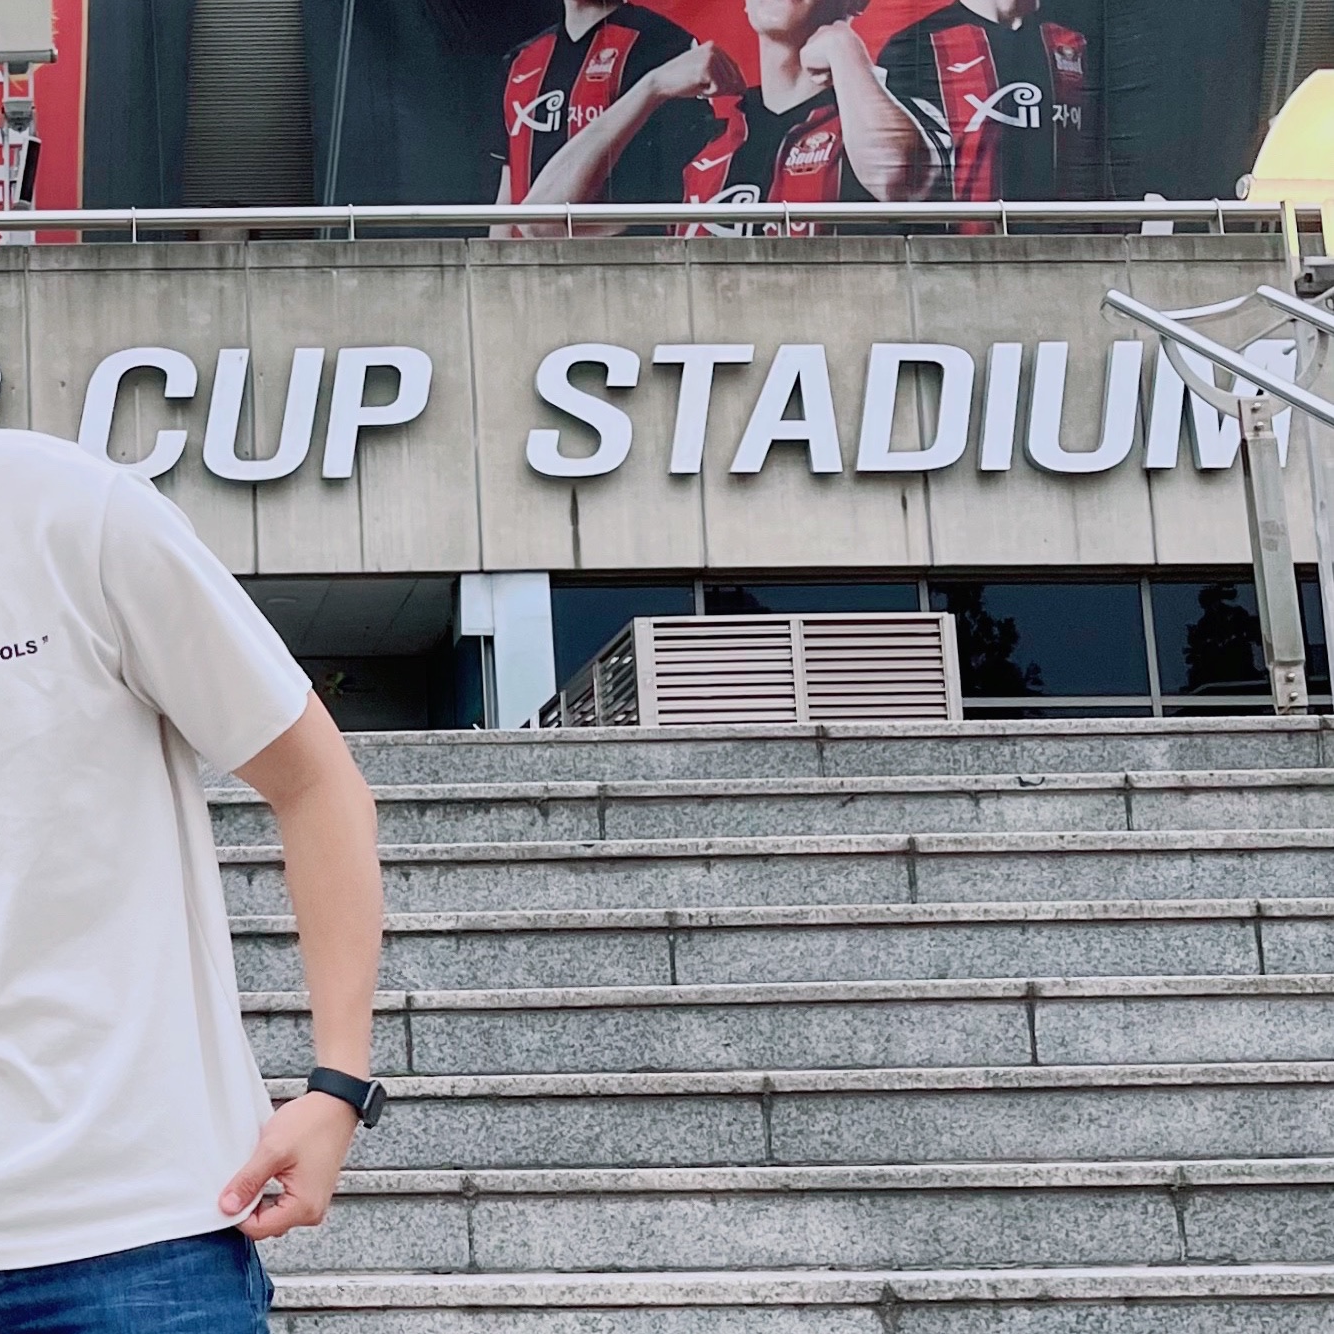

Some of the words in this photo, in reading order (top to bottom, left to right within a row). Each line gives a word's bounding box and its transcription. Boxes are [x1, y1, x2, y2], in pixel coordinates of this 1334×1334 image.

[1052, 104, 1082, 131] 자이
[77, 346, 433, 482] CUP
[526, 339, 1298, 478] STADIUM
